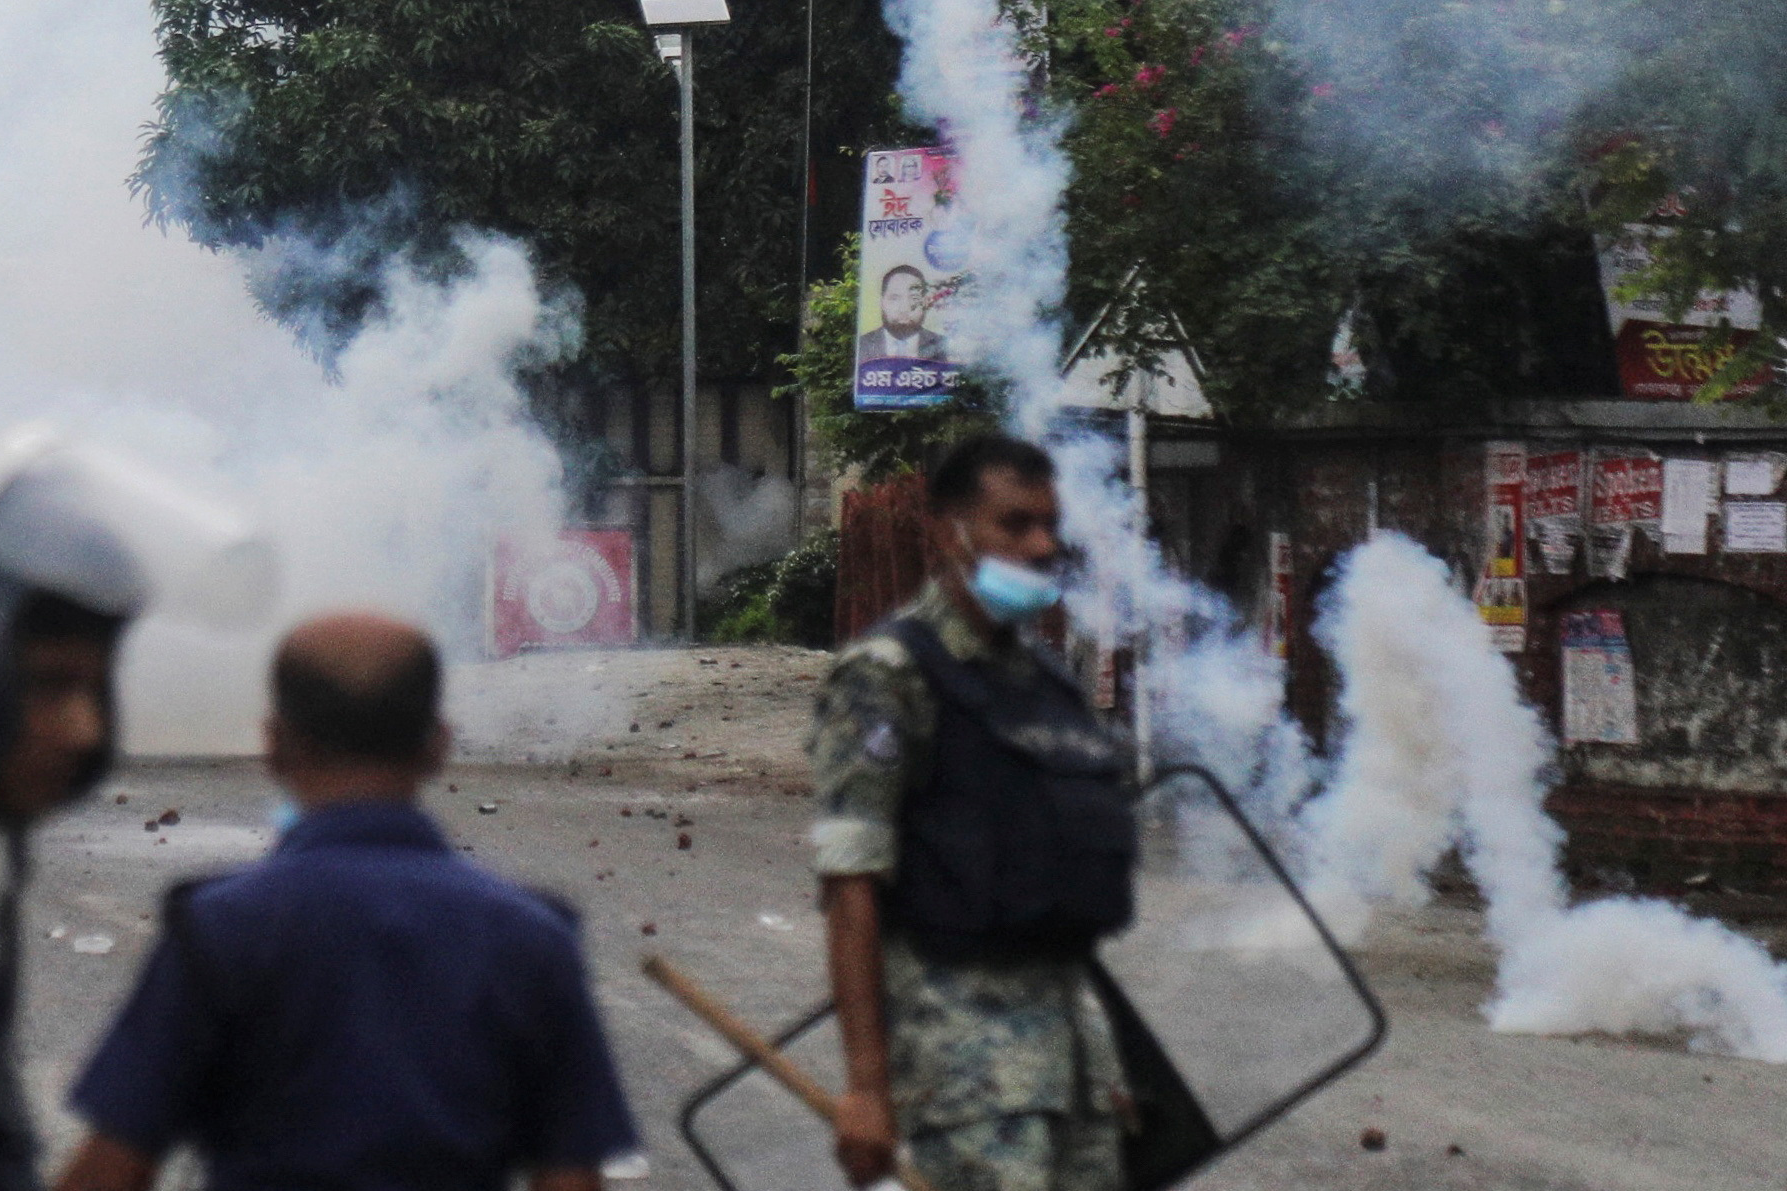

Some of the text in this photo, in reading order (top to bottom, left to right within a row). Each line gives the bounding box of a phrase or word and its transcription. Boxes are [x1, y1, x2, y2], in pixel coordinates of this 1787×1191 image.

[879, 189, 912, 219] ঈদ
[868, 218, 924, 240] মোবারক
[861, 370, 894, 388] এম
[895, 366, 938, 389] এইচ
